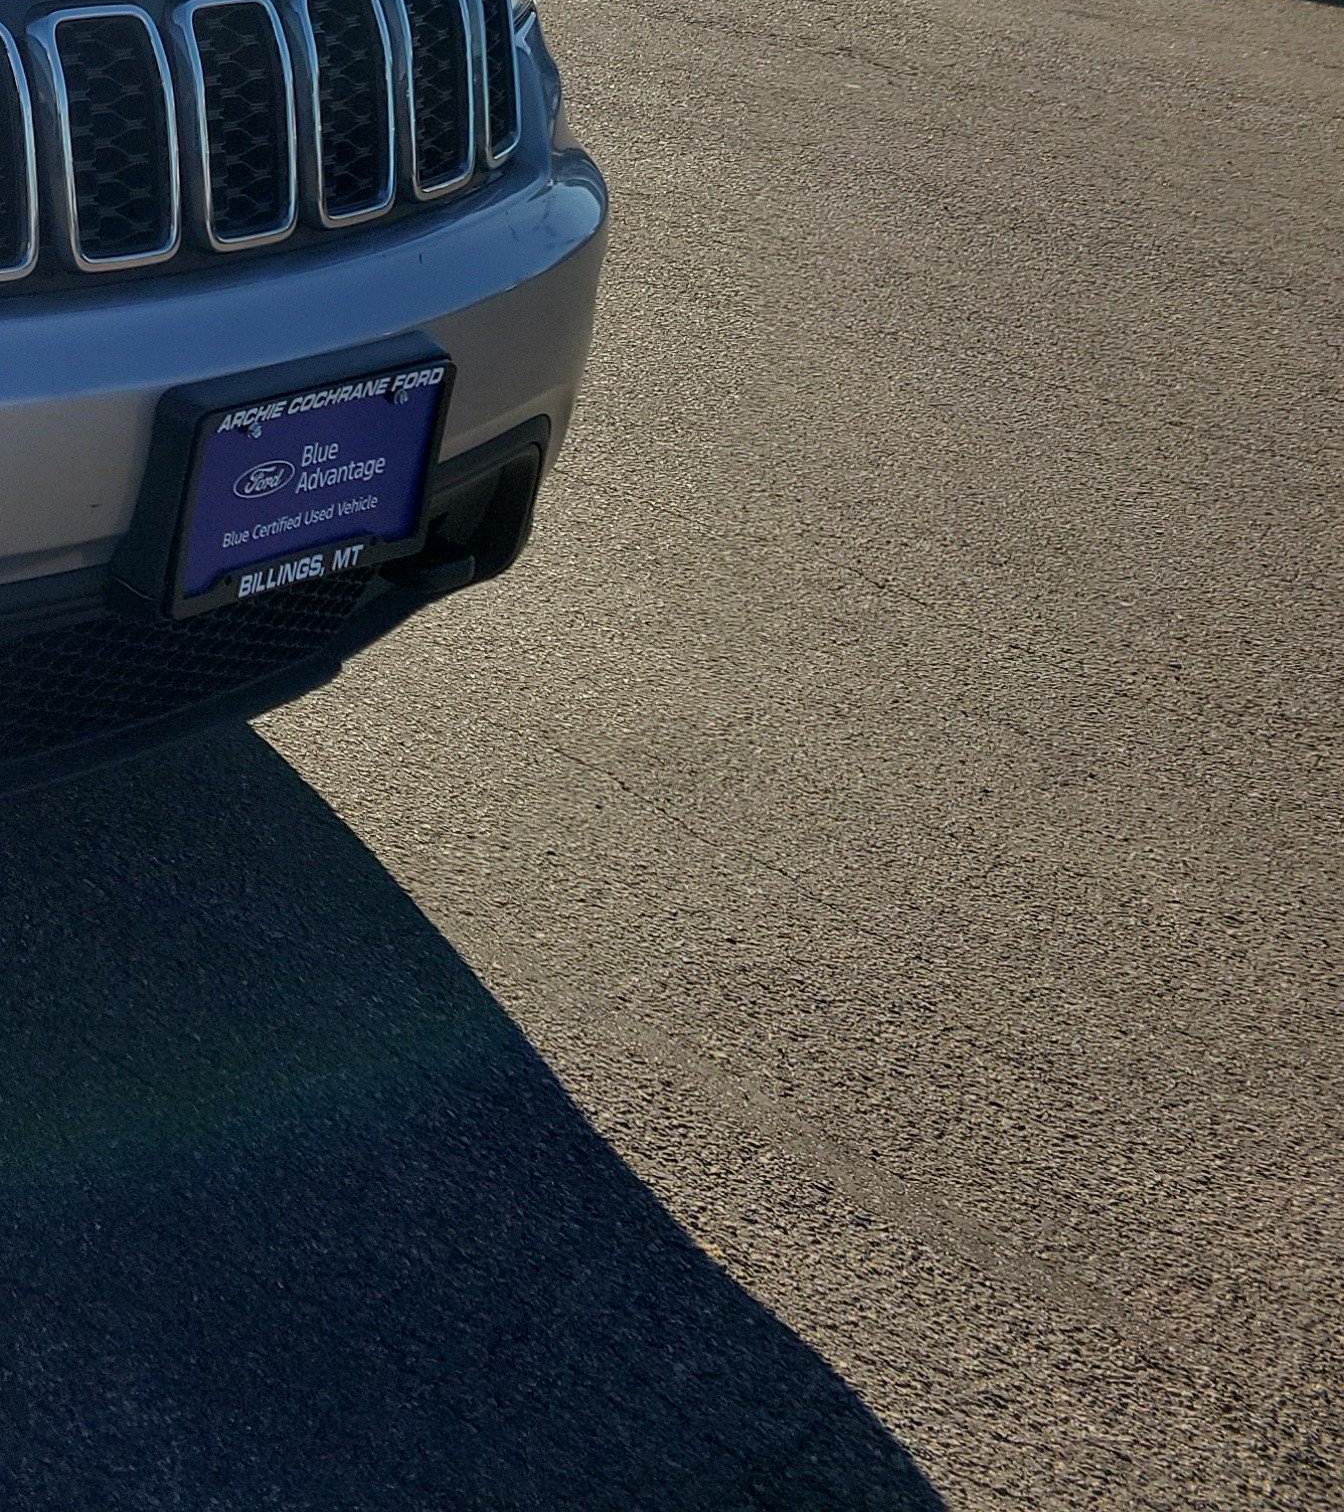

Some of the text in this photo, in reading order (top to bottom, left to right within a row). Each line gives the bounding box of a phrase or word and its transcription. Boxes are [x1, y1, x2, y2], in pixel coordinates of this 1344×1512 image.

[216, 367, 445, 434] ARCHIE COCHRANE FORD
[295, 457, 386, 495] Advantage
[301, 442, 339, 467] Blue
[244, 466, 285, 494] Ford
[222, 495, 379, 549] Blue Certified Used Vehicle
[238, 544, 364, 598] BILLINGS, MT
